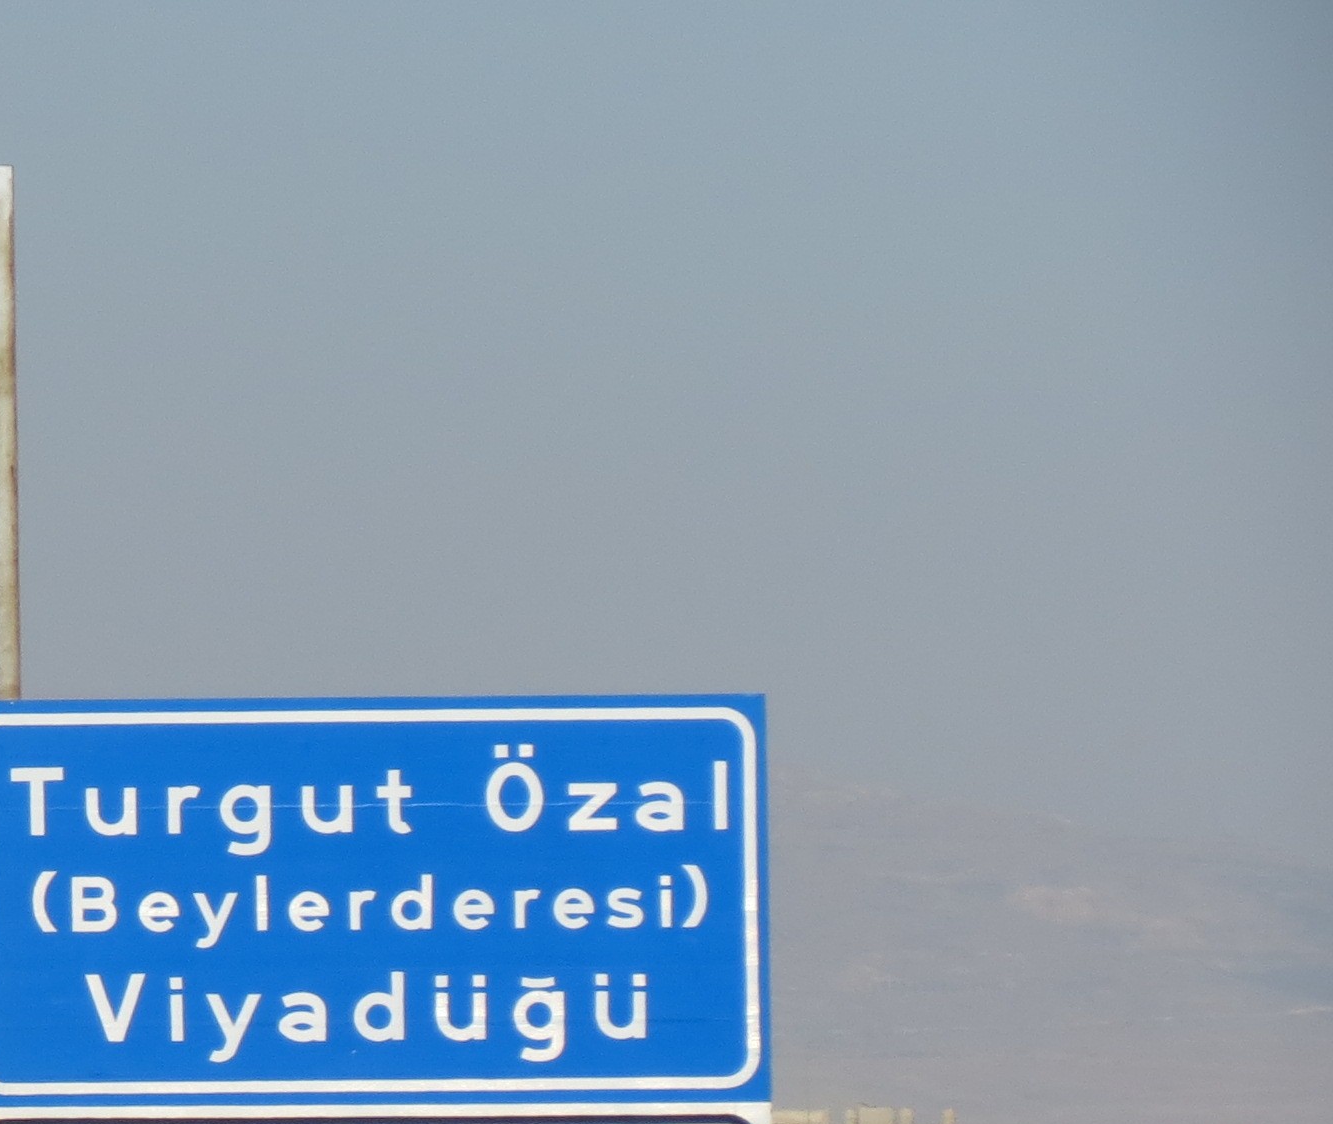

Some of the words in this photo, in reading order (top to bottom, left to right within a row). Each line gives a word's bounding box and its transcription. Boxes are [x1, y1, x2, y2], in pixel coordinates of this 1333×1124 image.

[10, 766, 412, 857] Turgut
[485, 743, 729, 833] Özal
[31, 864, 708, 949] (Beylerderesi)
[85, 970, 647, 1063] Viyadüğü
